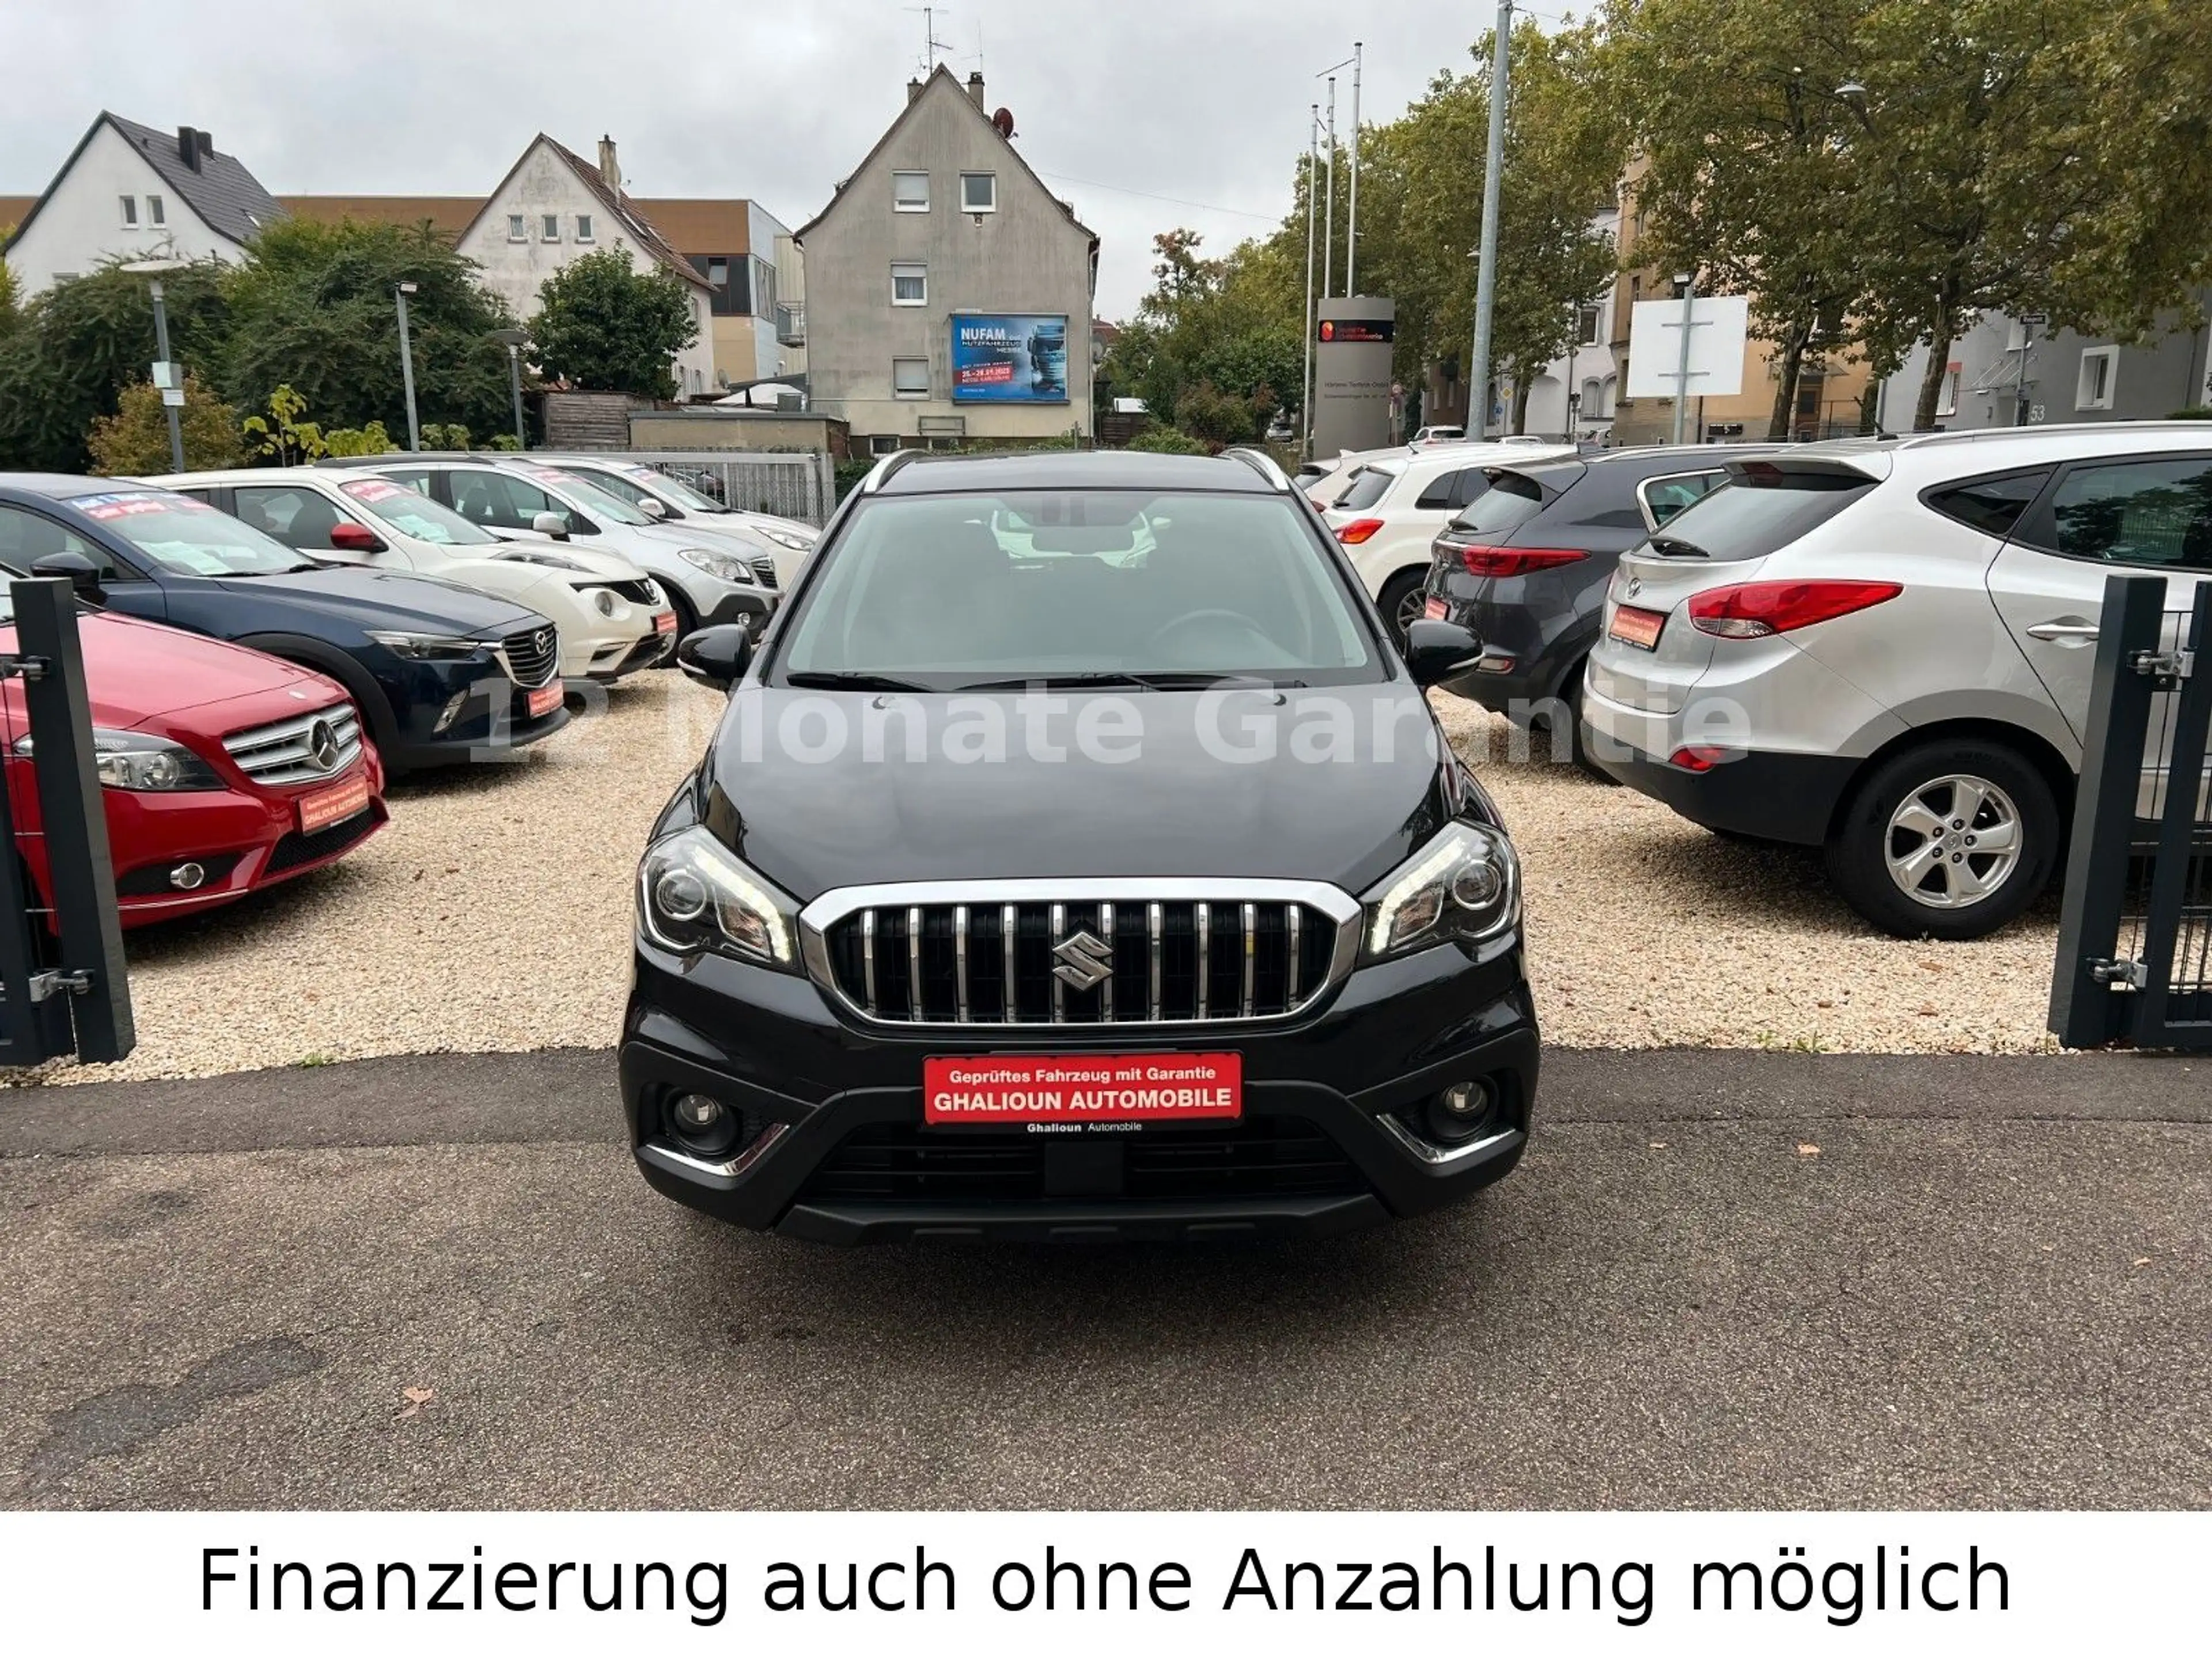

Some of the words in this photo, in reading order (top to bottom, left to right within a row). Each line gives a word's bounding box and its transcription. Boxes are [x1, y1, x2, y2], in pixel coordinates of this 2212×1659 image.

[961, 327, 1006, 340] NUFAM
[2030, 405, 2046, 421] 53
[949, 1069, 1031, 1086] Geprüftes
[1035, 1068, 1110, 1084] Fahrzeug
[1115, 1067, 1141, 1081] mit
[1146, 1066, 1216, 1081] Garantie
[934, 1092, 1061, 1112] GHALIOUN
[1069, 1088, 1232, 1110] AUTOMOBILE
[1027, 1123, 1082, 1133] Ghalioun
[1088, 1122, 1142, 1132] Automobile
